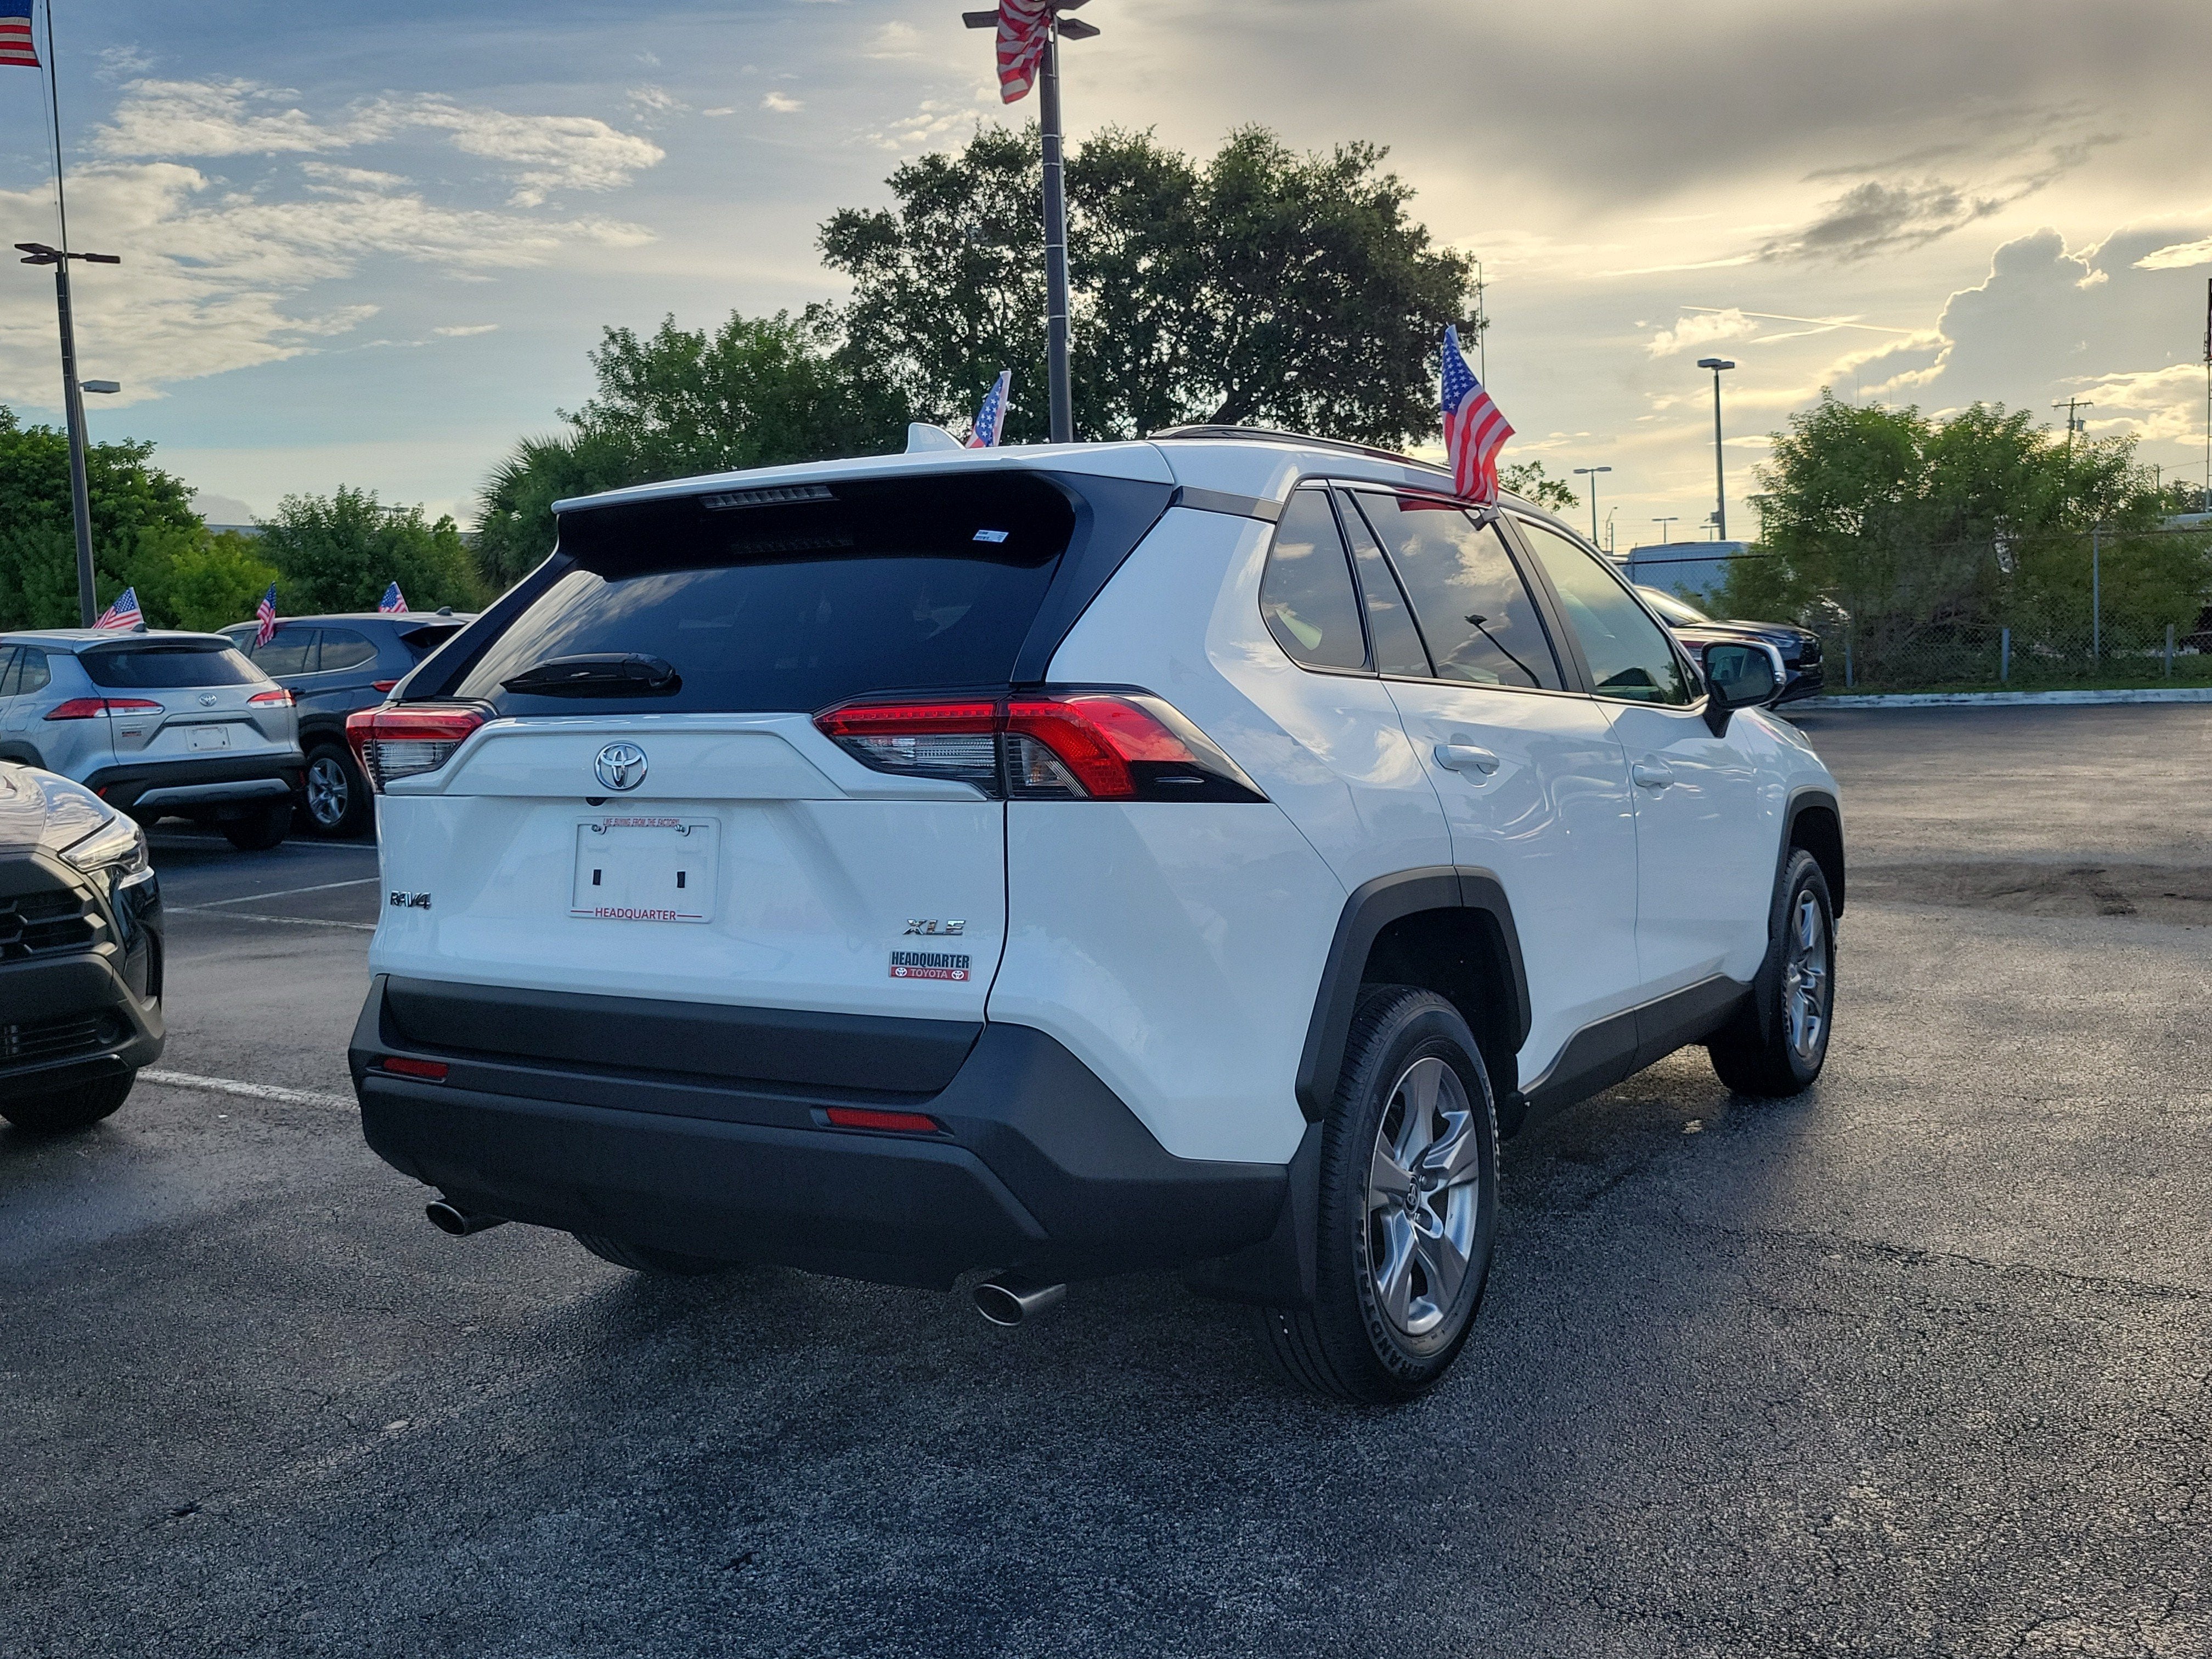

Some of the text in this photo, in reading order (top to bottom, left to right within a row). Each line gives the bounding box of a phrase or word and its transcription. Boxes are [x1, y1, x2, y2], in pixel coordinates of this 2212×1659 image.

[390, 890, 432, 910] RAV4
[595, 907, 676, 920] HEADQUARTER
[902, 918, 966, 935] XLE
[891, 951, 969, 968] HEADQUARTER
[911, 968, 947, 978] TOYOTA
